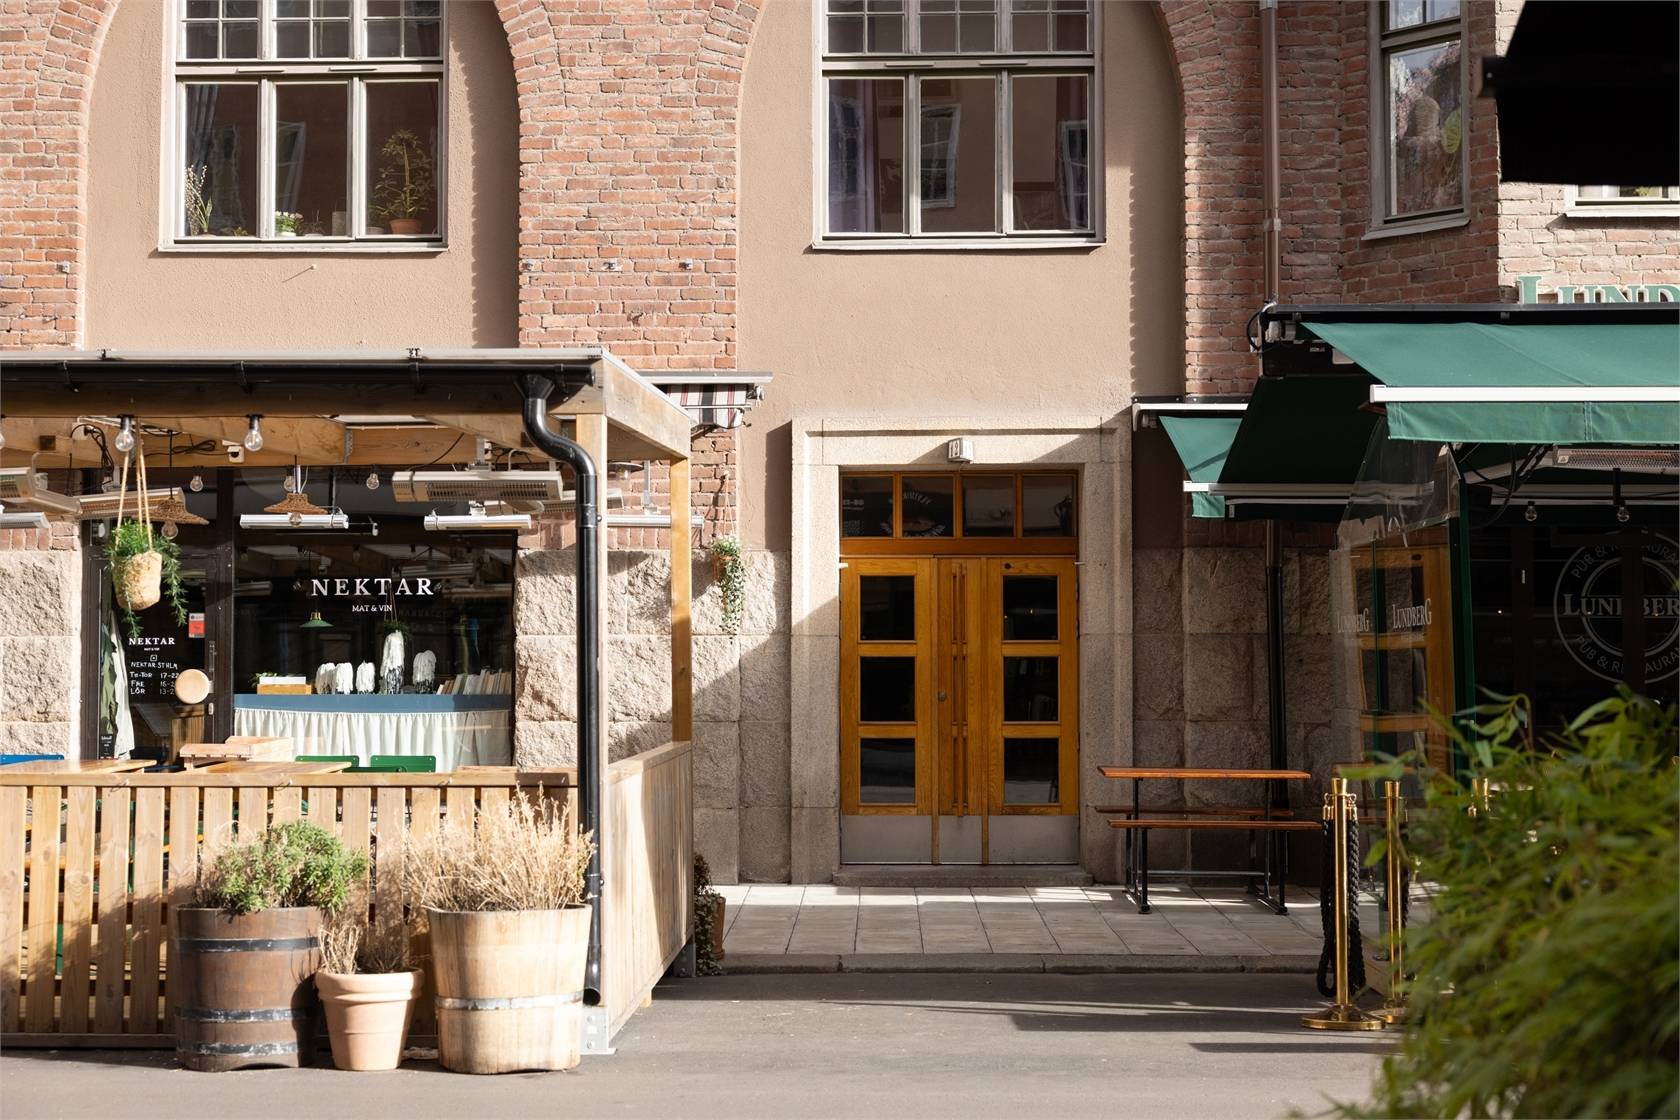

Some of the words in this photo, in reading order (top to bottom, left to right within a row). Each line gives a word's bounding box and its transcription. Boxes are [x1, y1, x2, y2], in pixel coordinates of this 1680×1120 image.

[311, 577, 434, 597] NEKTAR
[370, 604, 377, 612] &
[1391, 598, 1432, 628] LUNDBERG
[128, 637, 176, 646] NEKTAR
